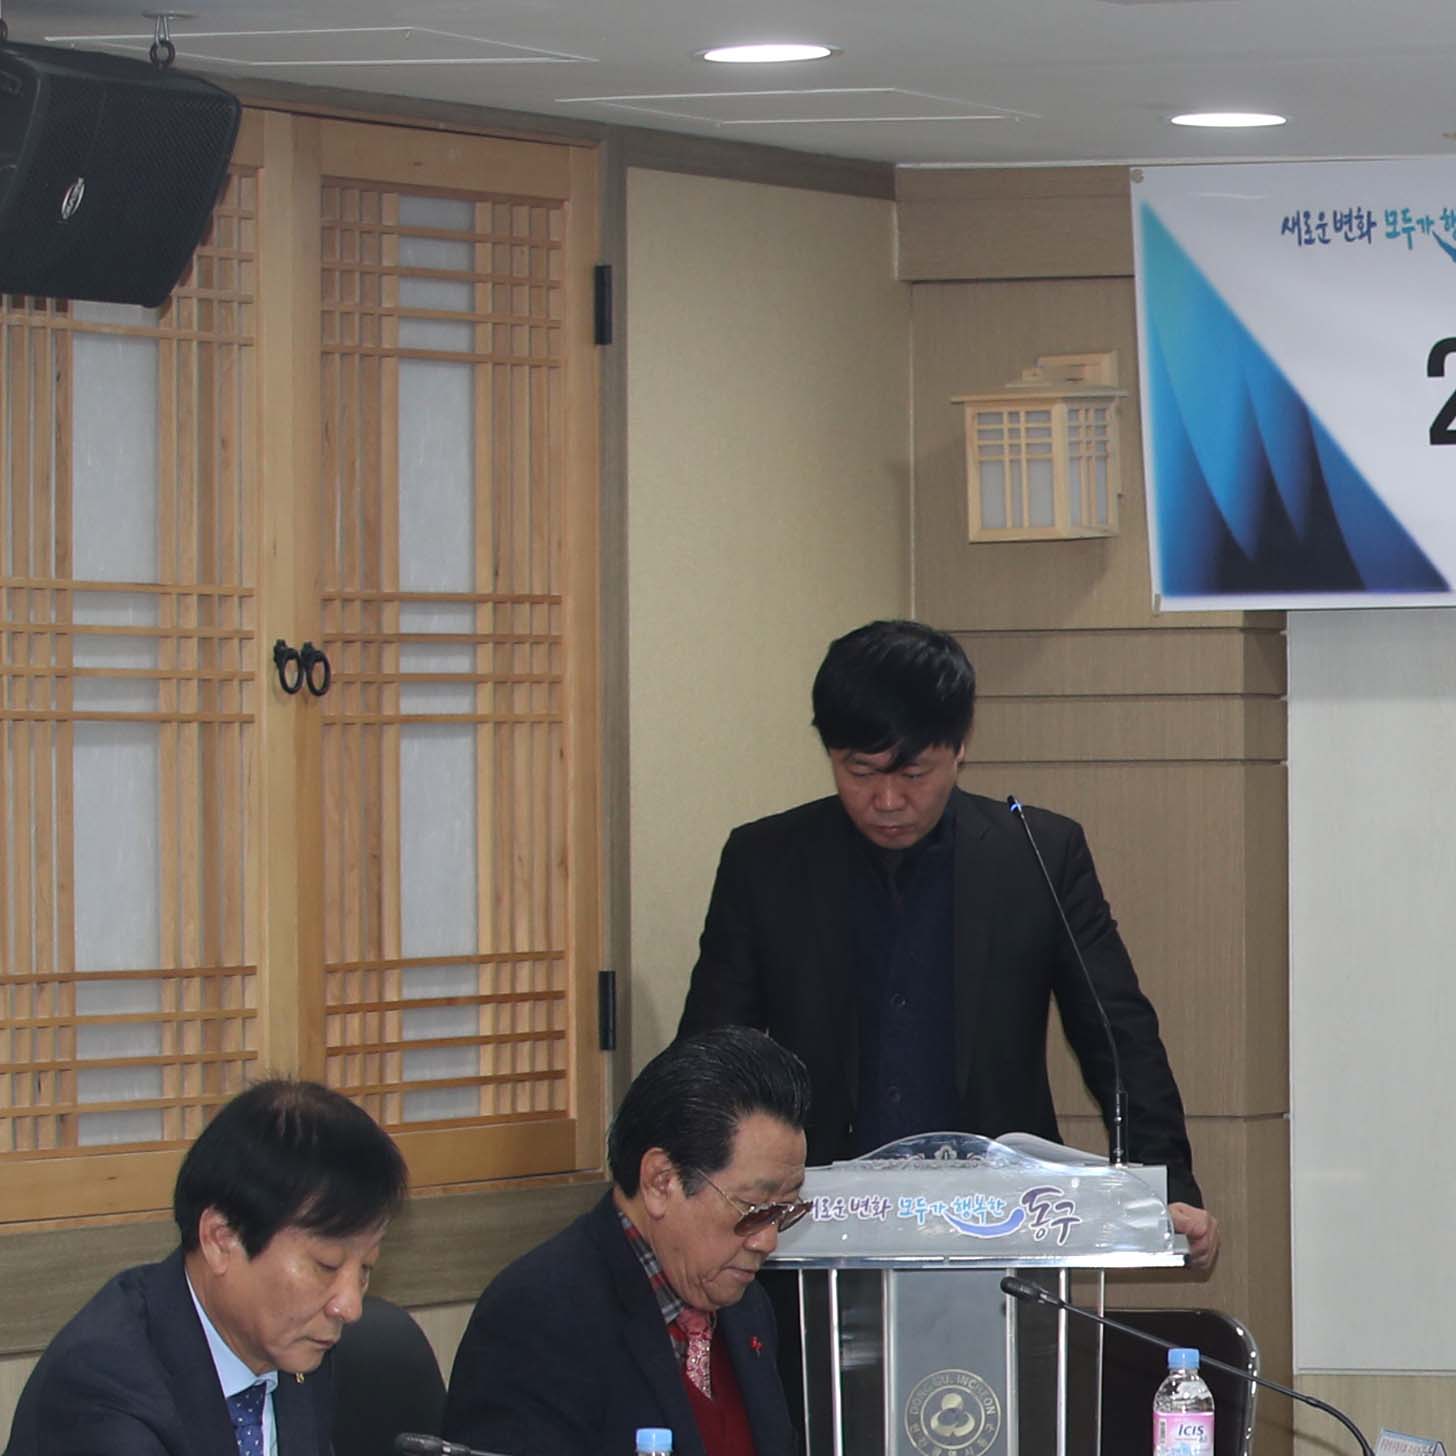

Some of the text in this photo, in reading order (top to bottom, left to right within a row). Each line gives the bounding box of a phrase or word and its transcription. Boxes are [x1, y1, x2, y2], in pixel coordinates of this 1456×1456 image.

[1384, 206, 1435, 251] 모두가
[850, 1196, 890, 1220] 변화
[899, 1196, 944, 1225] 모두가
